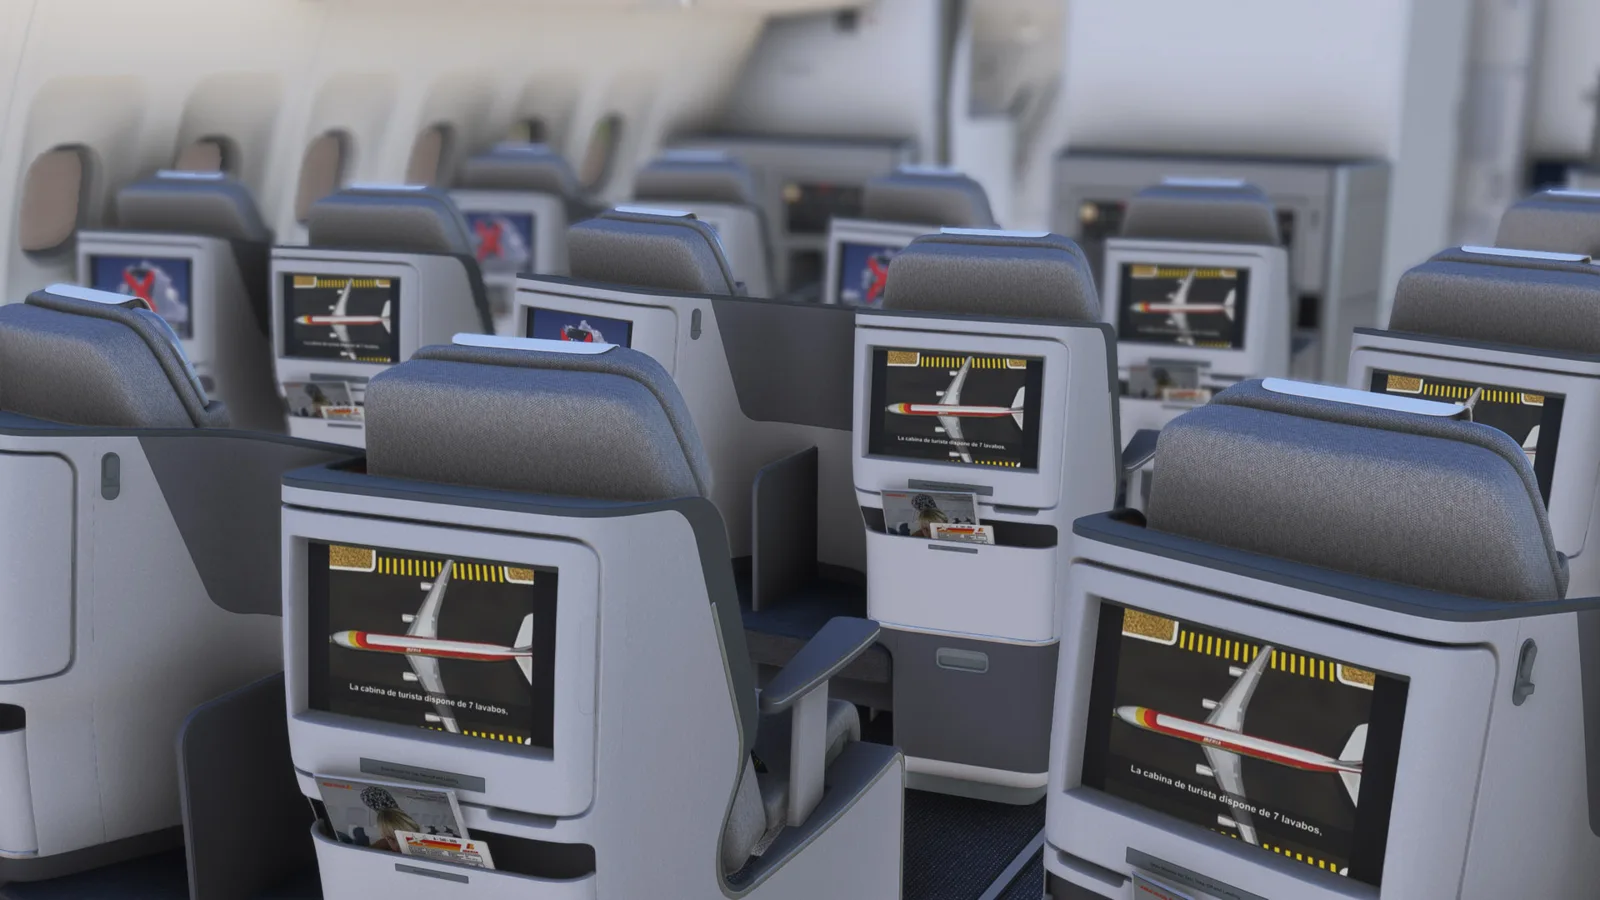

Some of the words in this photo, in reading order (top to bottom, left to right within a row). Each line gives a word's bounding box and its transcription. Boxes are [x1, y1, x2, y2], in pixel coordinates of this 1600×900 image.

[949, 439, 970, 447] dispone
[349, 683, 359, 691] La
[360, 684, 386, 695] cabina
[387, 689, 397, 697] de
[398, 691, 423, 701] turista
[424, 694, 456, 707] dispone
[457, 700, 467, 708] de
[1130, 764, 1142, 775] La
[1143, 769, 1173, 785] cabina
[1174, 779, 1186, 790] de
[1187, 783, 1217, 800] turista
[1218, 794, 1257, 813] dispone
[1258, 807, 1271, 819] de
[1273, 812, 1280, 820] 7
